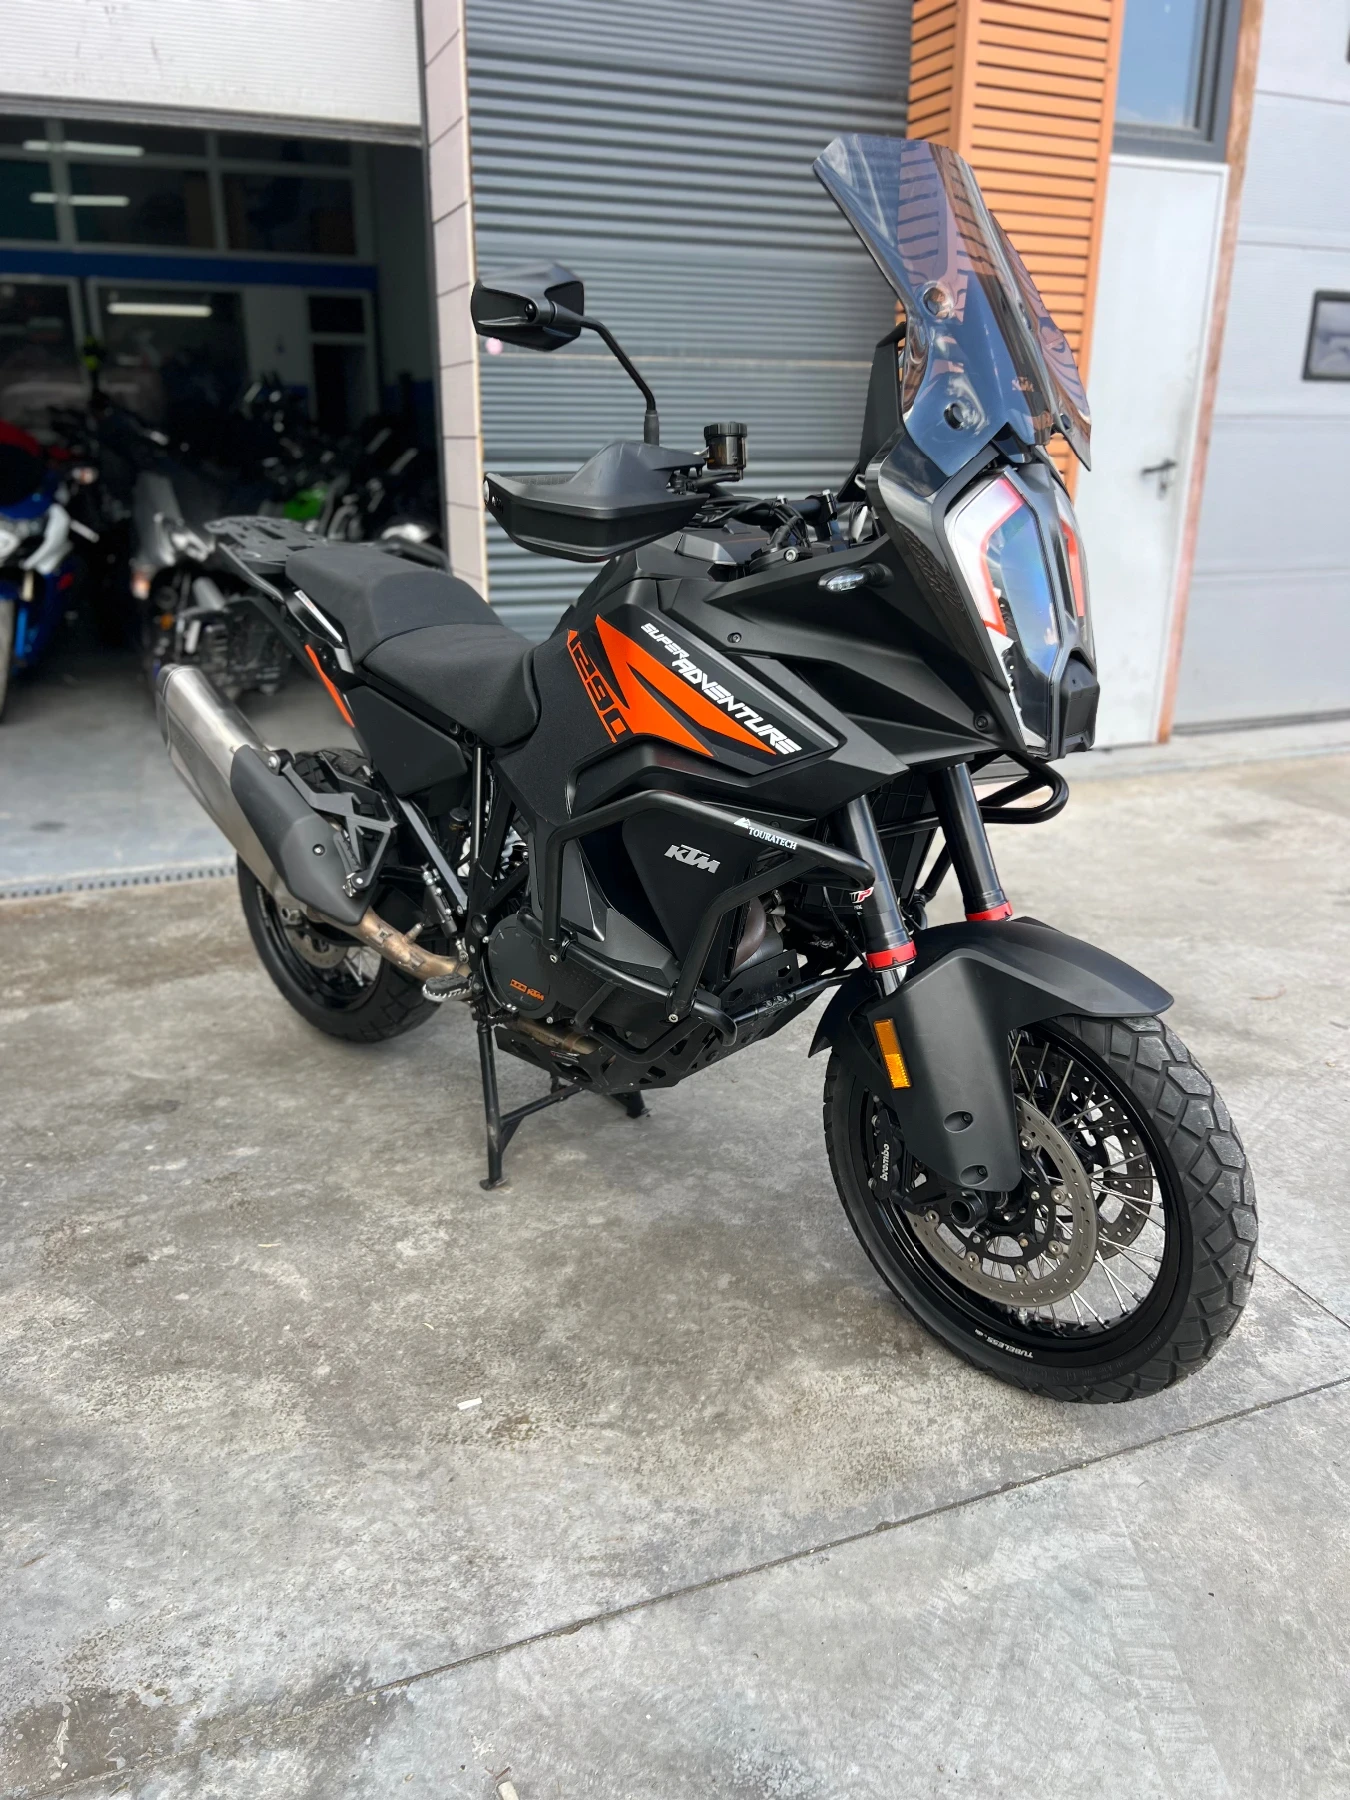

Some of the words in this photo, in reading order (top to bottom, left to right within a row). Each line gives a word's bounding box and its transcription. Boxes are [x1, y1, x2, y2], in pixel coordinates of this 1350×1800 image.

[640, 622, 690, 660] SUPER
[671, 658, 802, 755] ADVENTURE
[748, 827, 798, 850] TOURATECH
[664, 844, 721, 874] KTM
[880, 1143, 890, 1182] brembo
[986, 1336, 1034, 1359] TUBELESS
